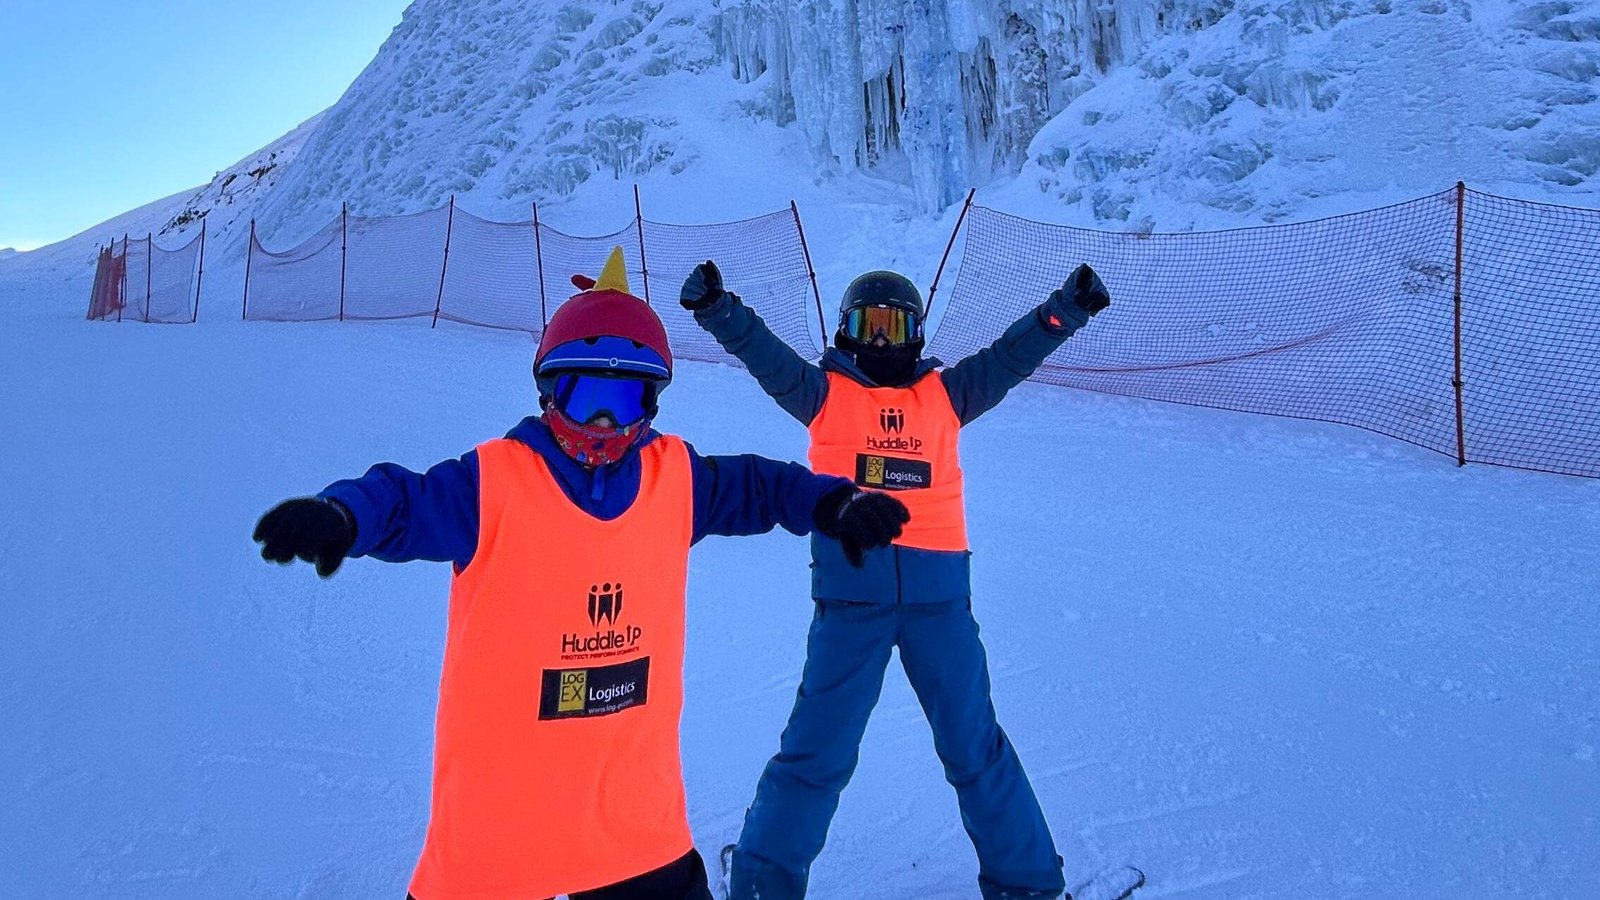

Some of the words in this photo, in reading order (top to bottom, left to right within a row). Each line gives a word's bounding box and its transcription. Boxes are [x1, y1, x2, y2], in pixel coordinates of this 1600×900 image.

[868, 466, 881, 477] EX
[885, 469, 923, 483] Logistics
[562, 673, 585, 685] LOG
[561, 685, 583, 702] EX
[589, 681, 635, 703] Logistics
